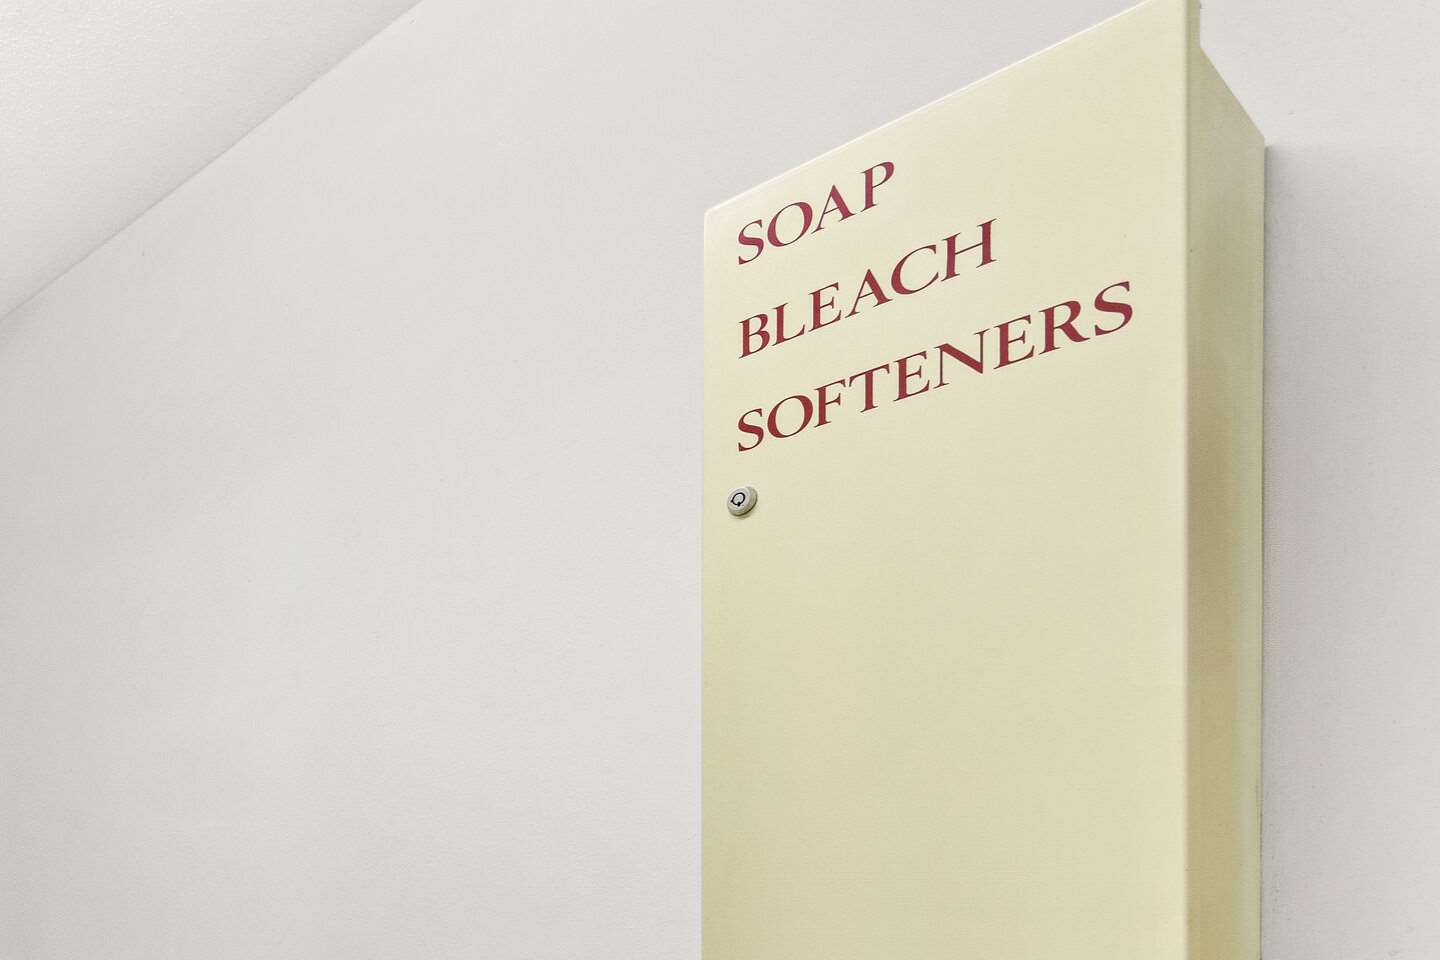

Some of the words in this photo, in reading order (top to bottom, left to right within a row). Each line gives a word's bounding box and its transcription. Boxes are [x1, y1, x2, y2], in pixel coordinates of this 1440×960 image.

[737, 160, 895, 266] SOAP
[738, 218, 998, 359] BLEACH
[737, 281, 1134, 453] SOFTENERS
